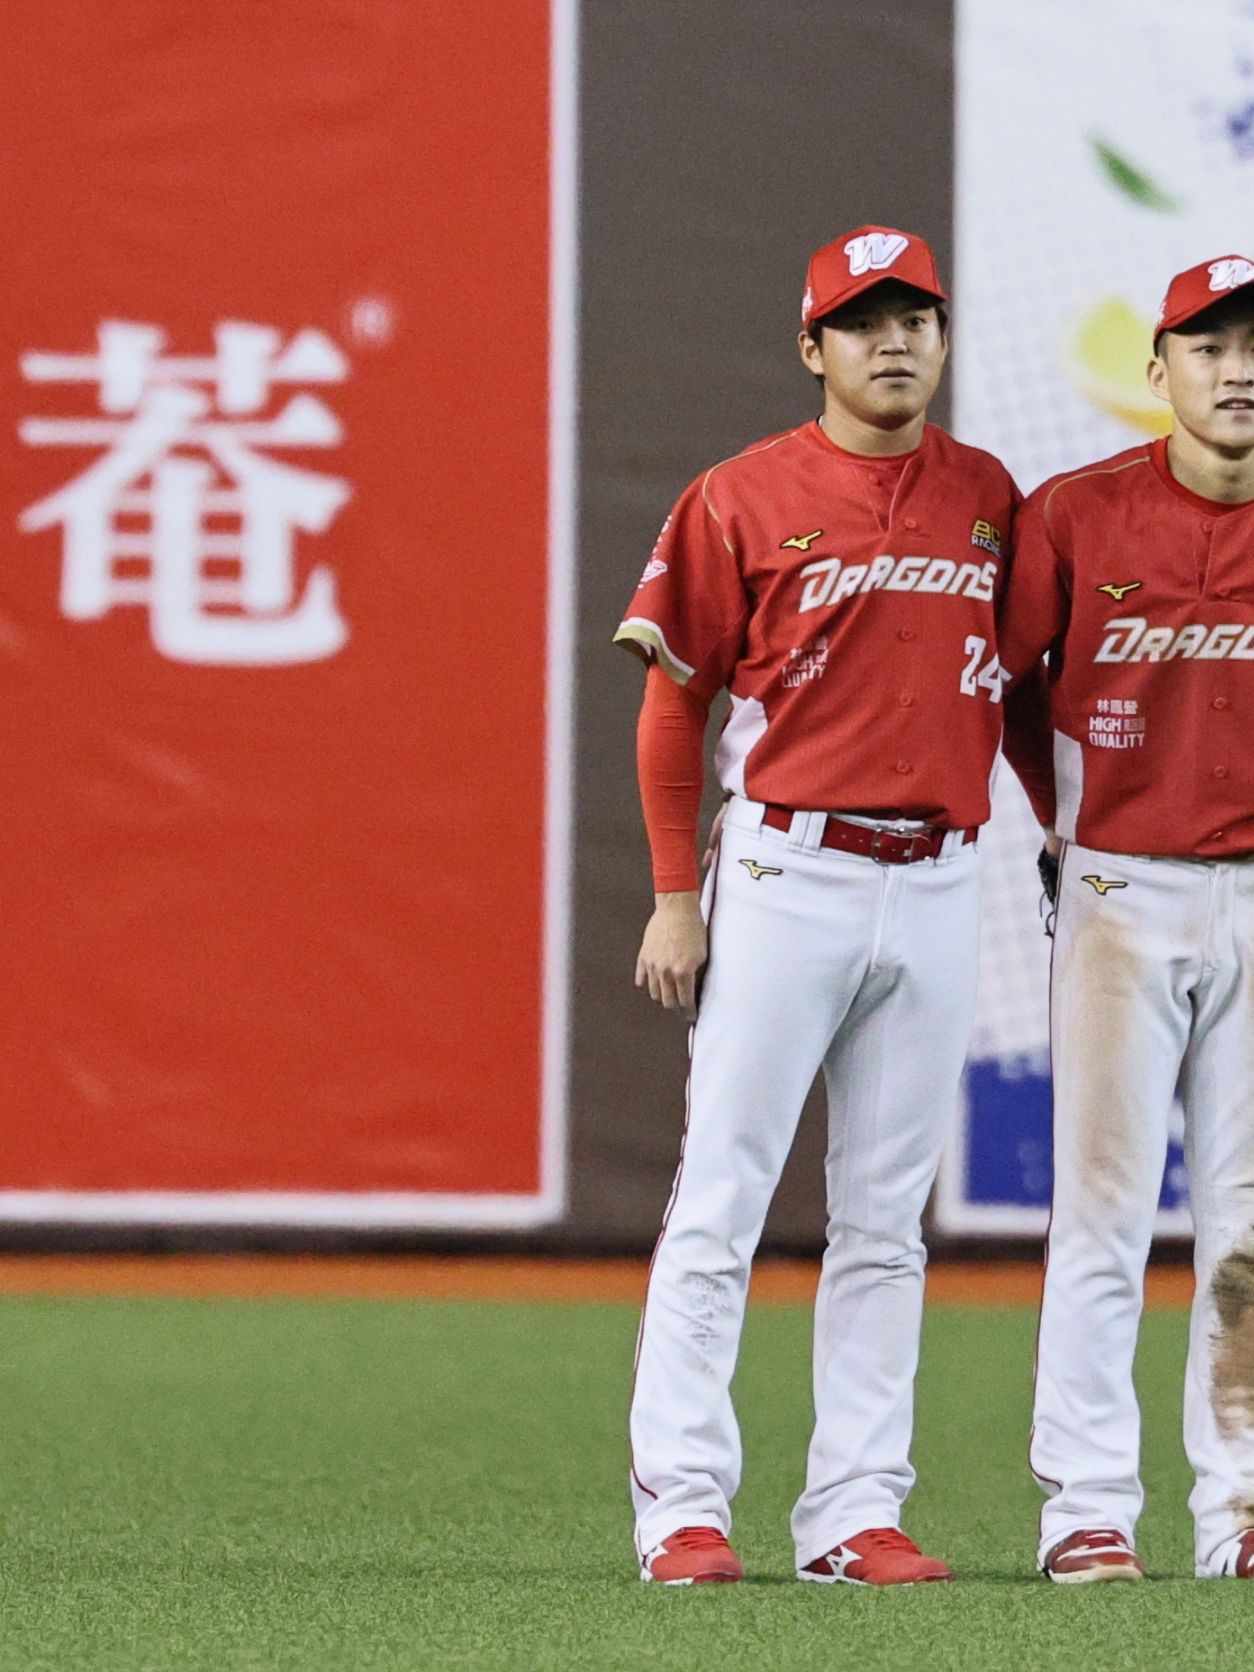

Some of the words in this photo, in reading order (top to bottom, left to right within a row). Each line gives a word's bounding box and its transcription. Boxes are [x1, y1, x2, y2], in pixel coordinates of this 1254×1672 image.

[18, 320, 350, 664] 菴
[799, 555, 998, 613] DRAGONS
[960, 634, 1013, 704] 24
[1088, 732, 1145, 749] QUALITY
[1089, 716, 1121, 732] HIGH
